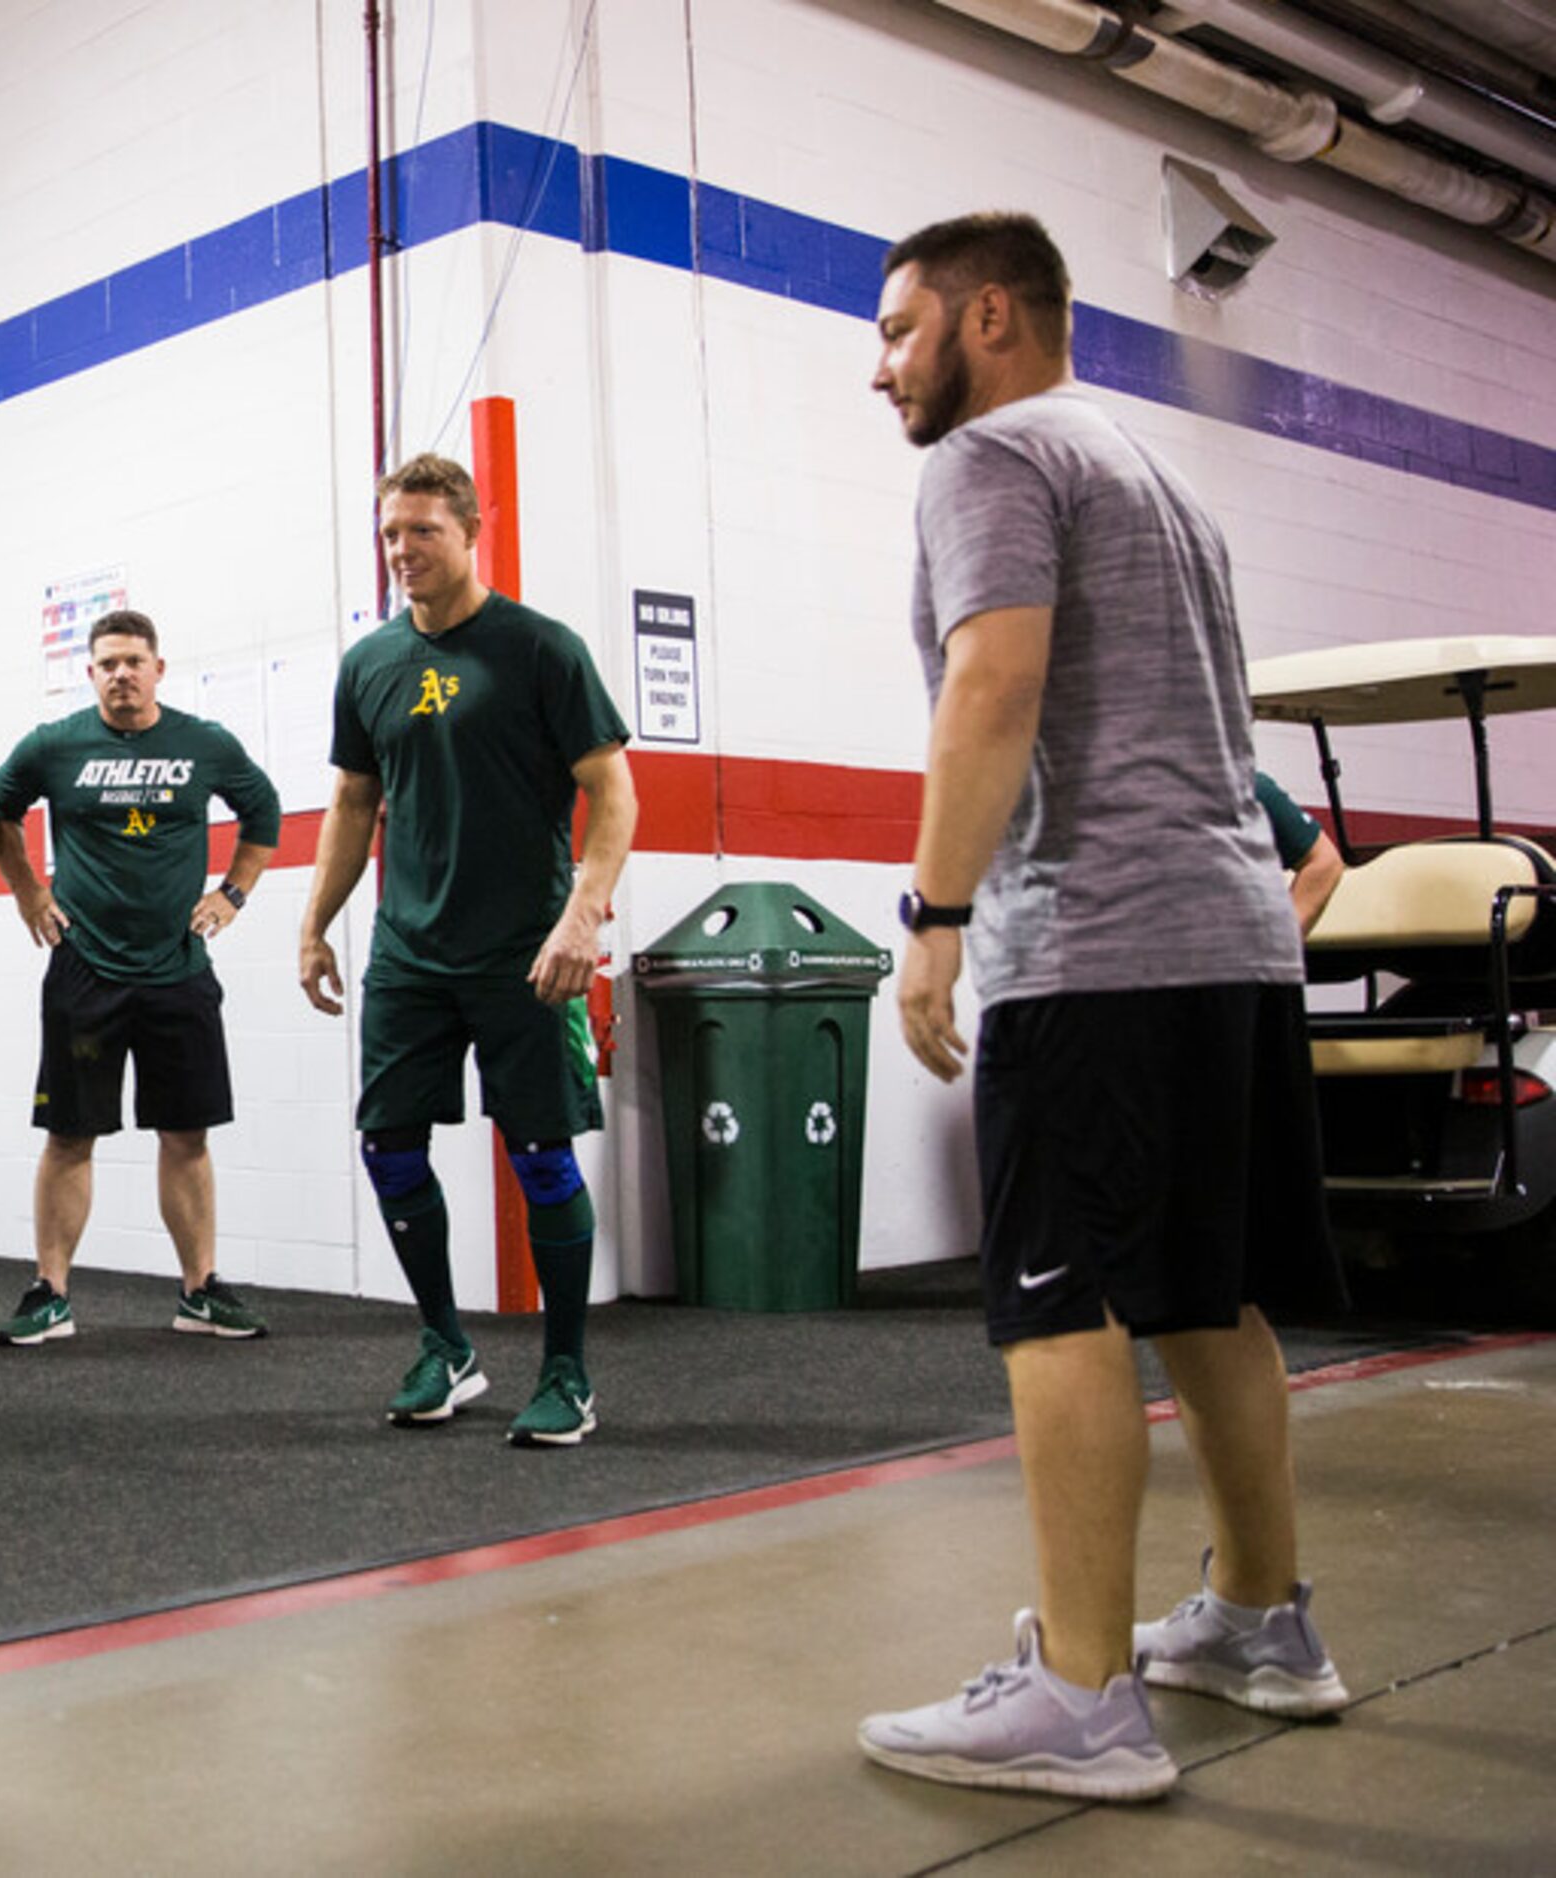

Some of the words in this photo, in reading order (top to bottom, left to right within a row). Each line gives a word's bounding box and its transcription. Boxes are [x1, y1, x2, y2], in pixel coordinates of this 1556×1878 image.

[639, 604, 654, 622] NO
[650, 645, 681, 662] PLEASE
[644, 666, 666, 682] TURN
[668, 670, 690, 684] YOUR
[649, 691, 687, 707] ENGINES
[660, 713, 677, 728] OFF
[74, 759, 195, 788] ATHLETICS
